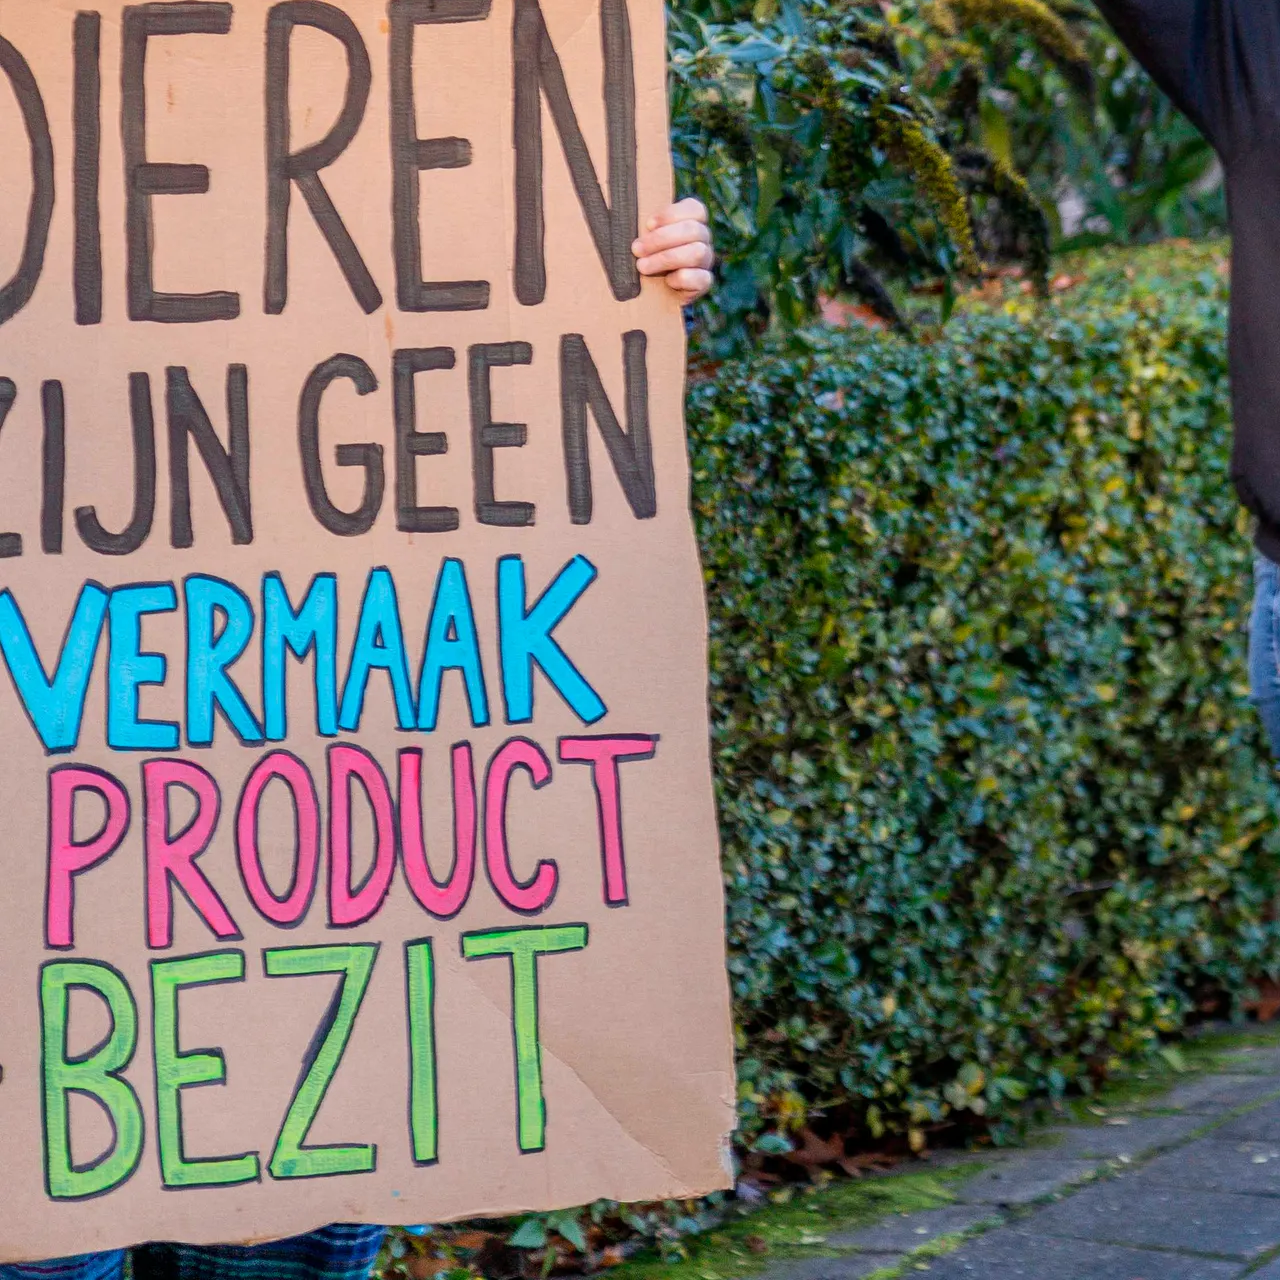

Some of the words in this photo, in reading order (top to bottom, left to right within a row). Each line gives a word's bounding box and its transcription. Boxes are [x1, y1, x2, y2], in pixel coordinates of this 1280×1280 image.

[0, 361, 255, 557] IJN
[297, 328, 657, 537] GEEN
[0, 553, 608, 756] VERMAAK
[44, 733, 661, 949] PRODUCT
[38, 922, 590, 1202] BEZIT
